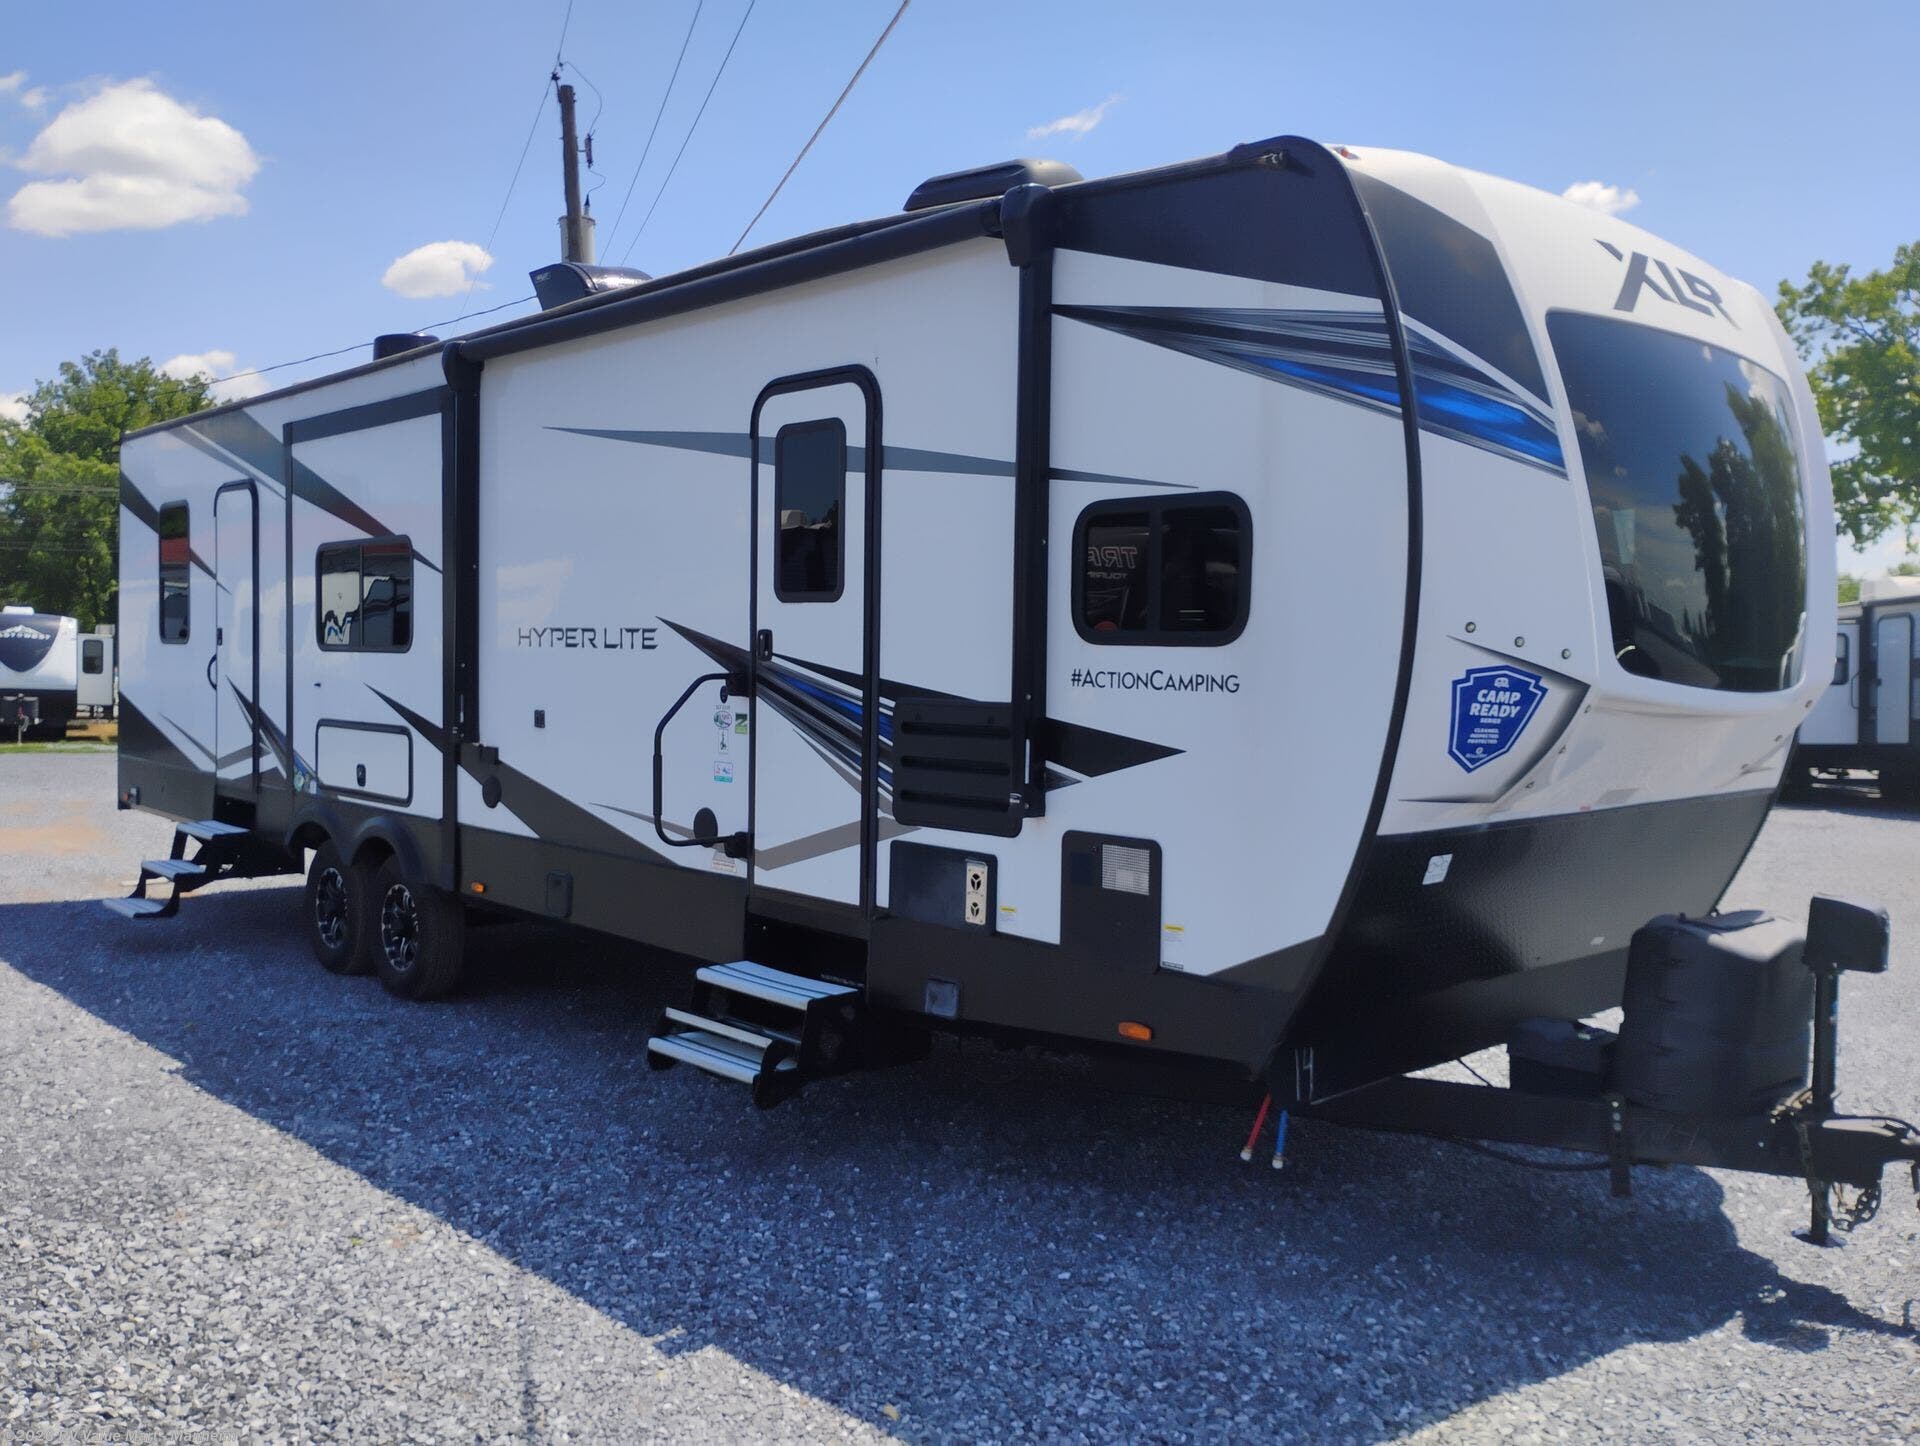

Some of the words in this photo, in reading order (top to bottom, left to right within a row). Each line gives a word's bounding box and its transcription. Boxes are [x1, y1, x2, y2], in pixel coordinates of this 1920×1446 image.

[1593, 238, 1742, 330] XLR
[1477, 689, 1521, 704] CAMP
[1469, 702, 1520, 718] READY
